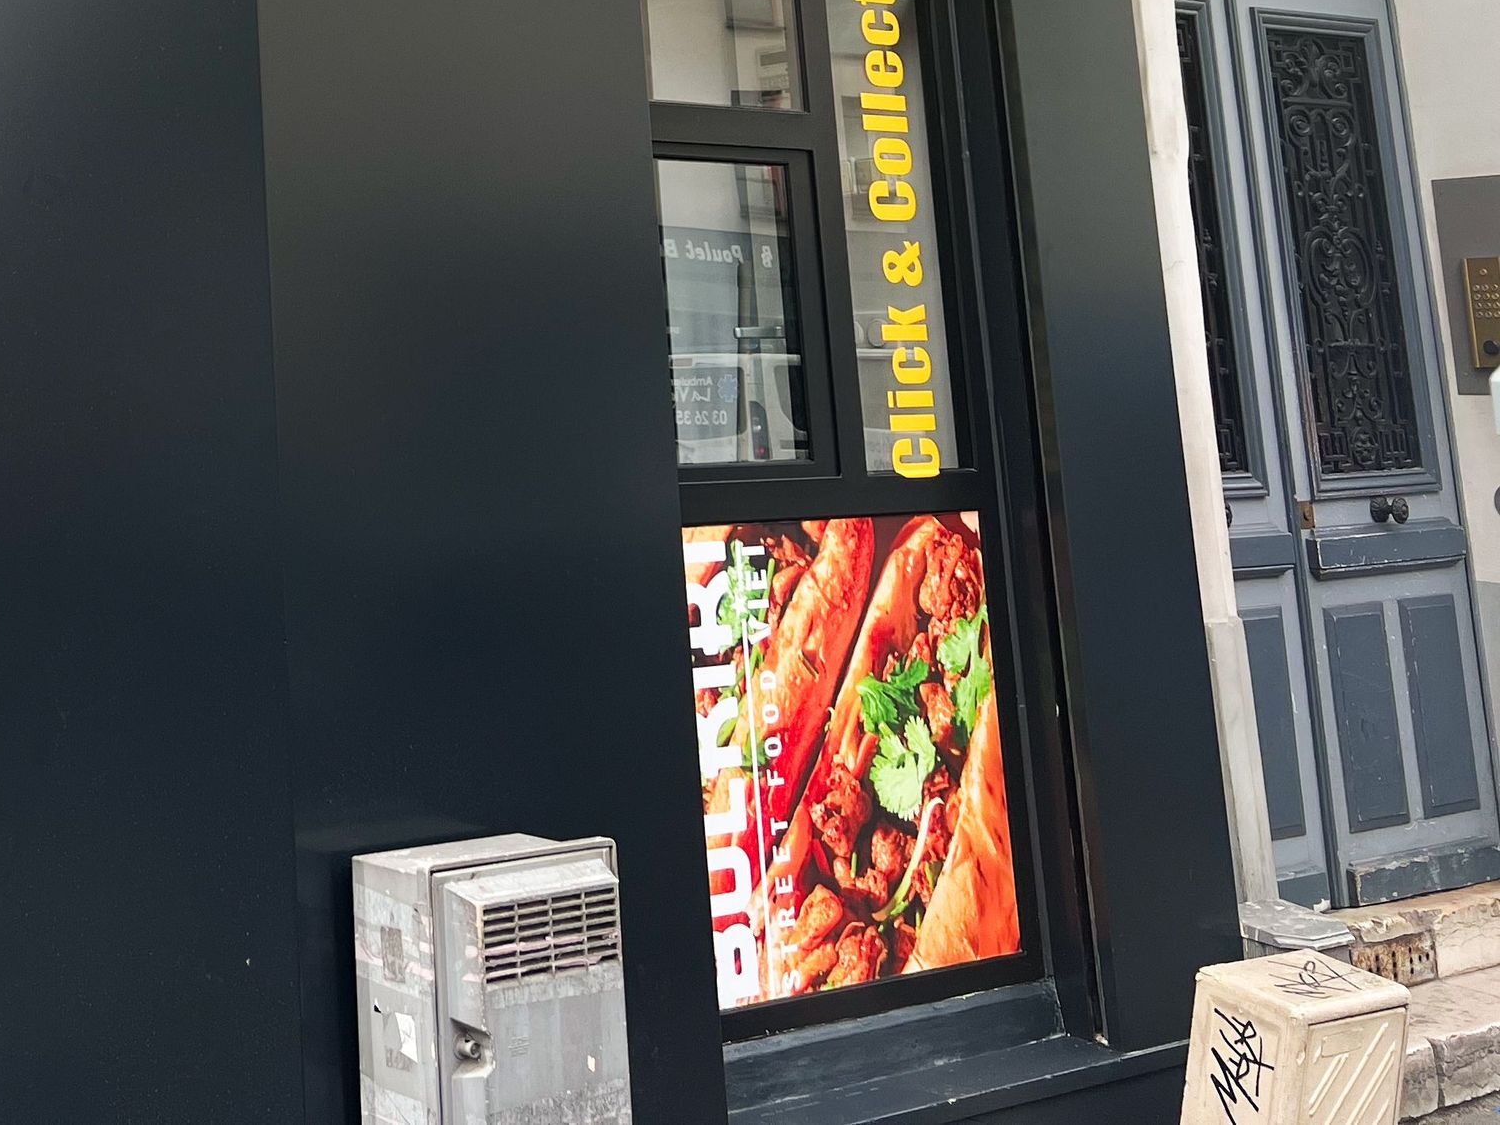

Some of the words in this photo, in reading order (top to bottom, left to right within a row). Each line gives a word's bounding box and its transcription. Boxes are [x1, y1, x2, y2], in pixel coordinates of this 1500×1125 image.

[882, 241, 922, 287] &
[880, 304, 941, 478] Click
[760, 670, 786, 787] FOOD
[770, 817, 803, 992] STREET
